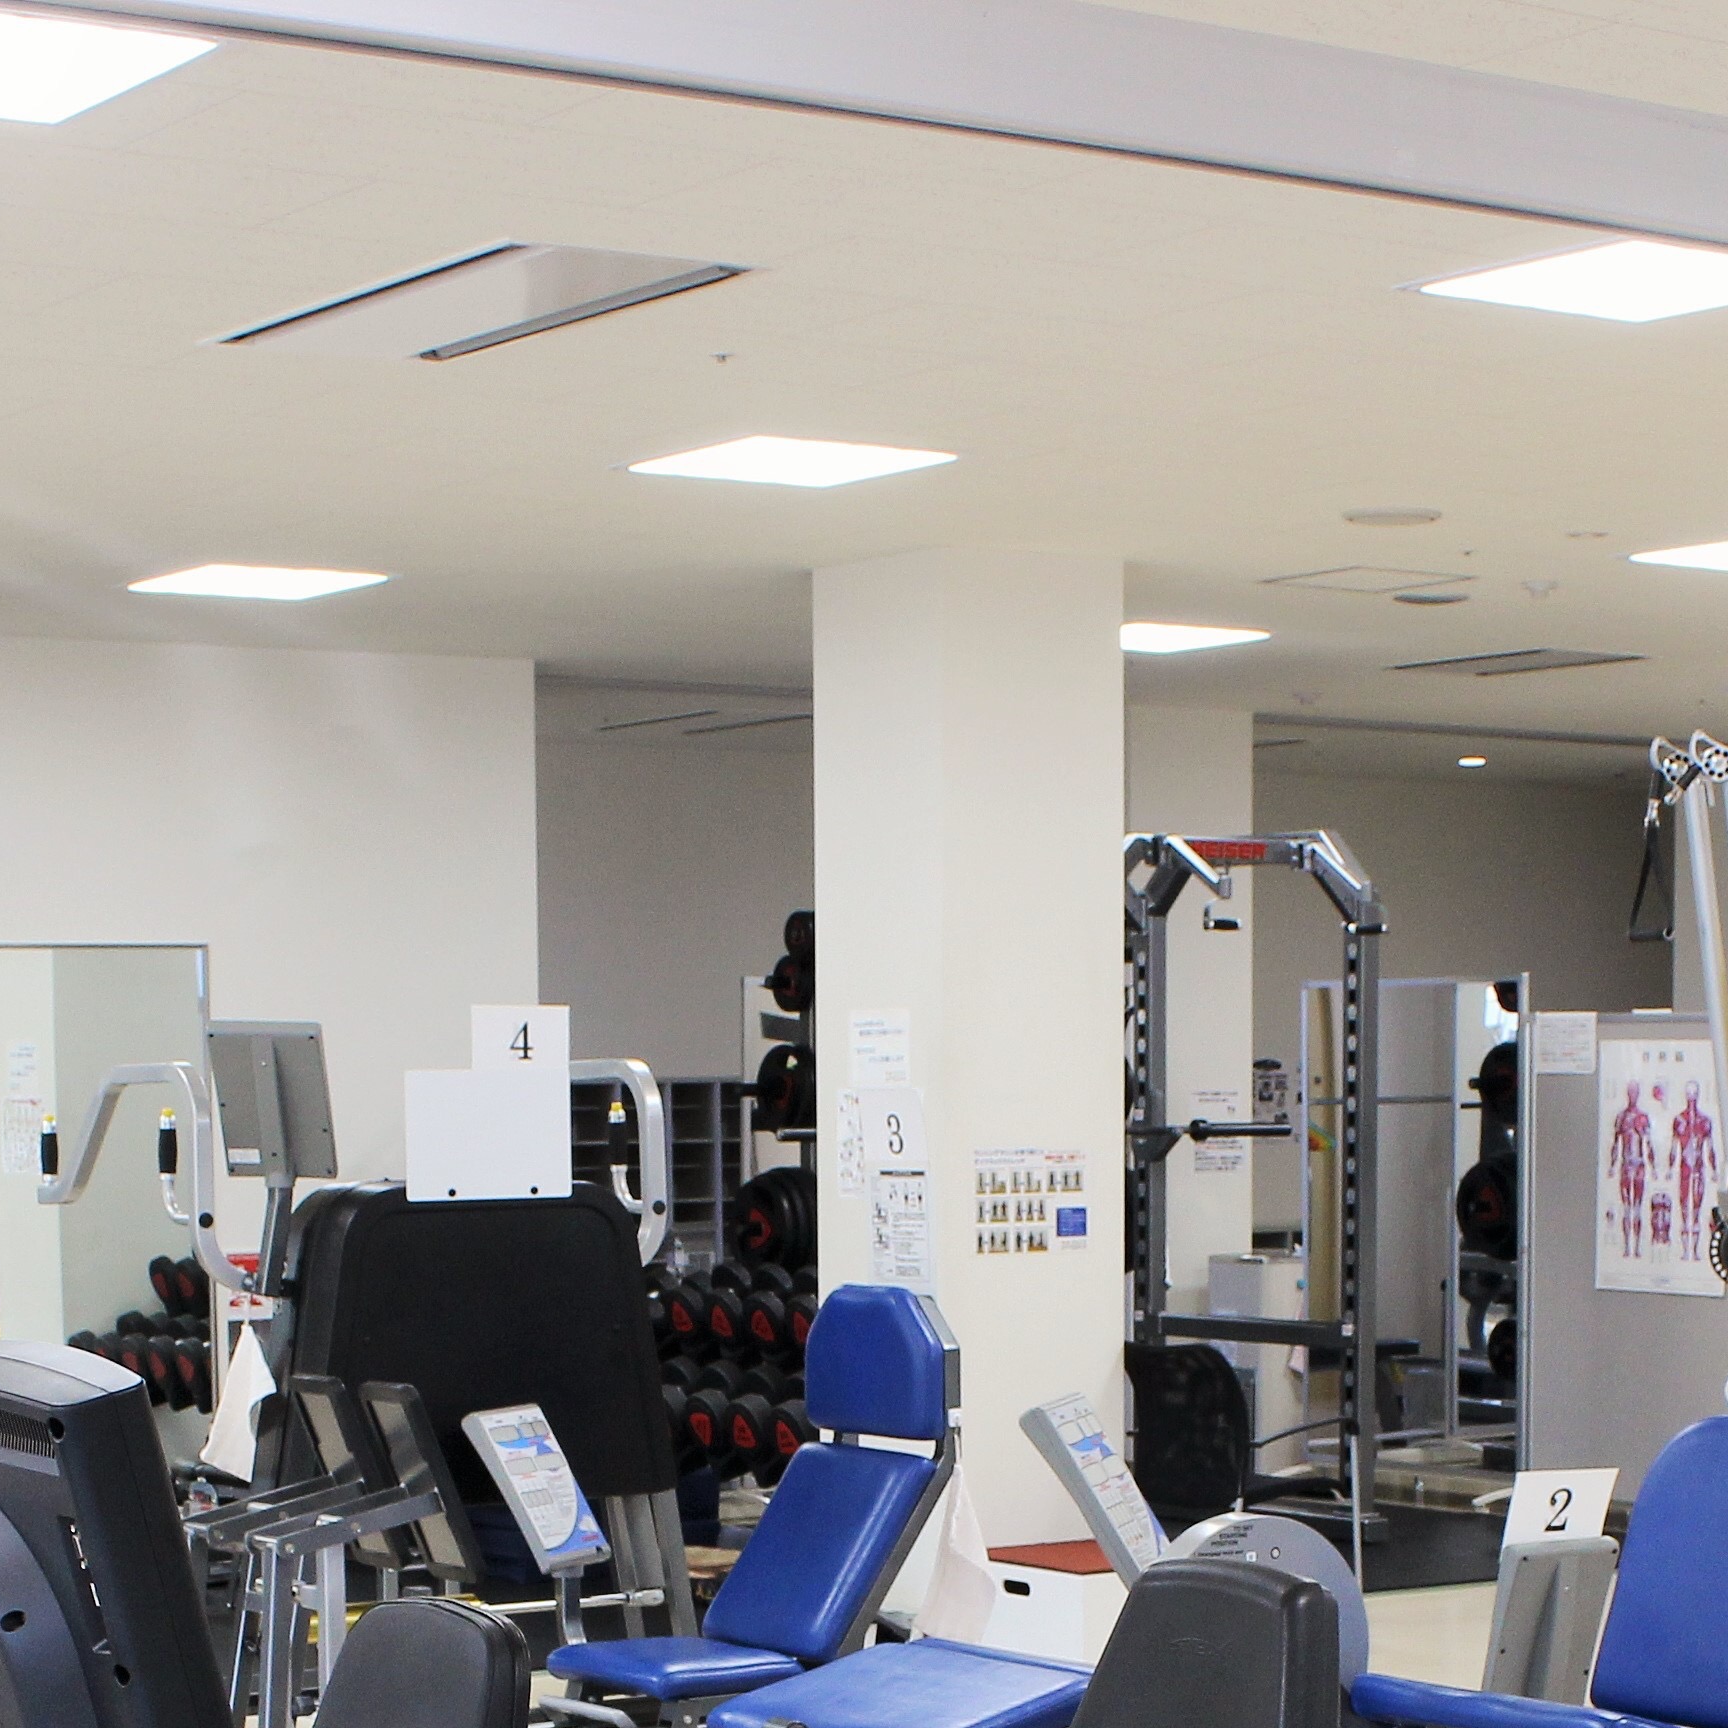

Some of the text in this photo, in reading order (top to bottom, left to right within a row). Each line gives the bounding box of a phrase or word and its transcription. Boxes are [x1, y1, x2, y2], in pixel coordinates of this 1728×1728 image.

[510, 1020, 534, 1060] 4
[886, 1113, 904, 1155] 3
[1544, 1488, 1572, 1532] 2
